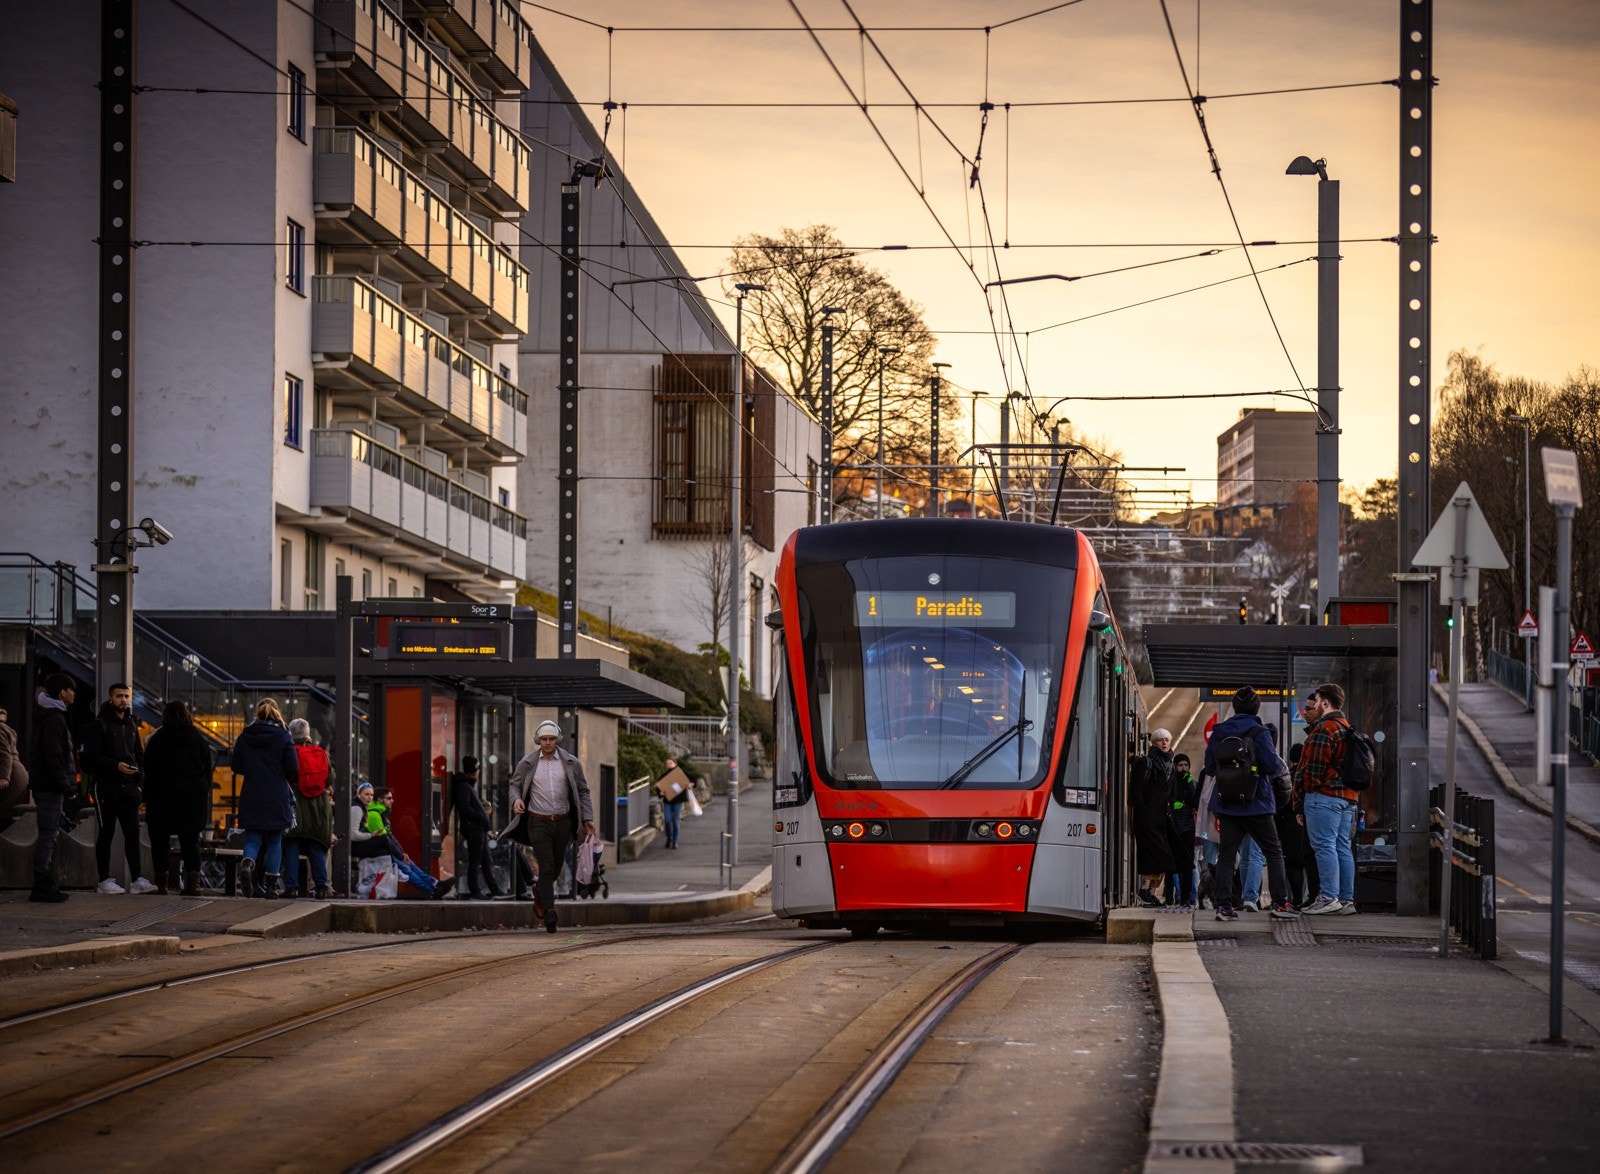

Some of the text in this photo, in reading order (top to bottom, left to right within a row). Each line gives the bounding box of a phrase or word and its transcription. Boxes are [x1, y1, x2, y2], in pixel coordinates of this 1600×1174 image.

[472, 606, 497, 616] Spor 2
[868, 596, 982, 616] 1 Paradis
[787, 821, 799, 835] 207
[1068, 824, 1082, 836] 207
